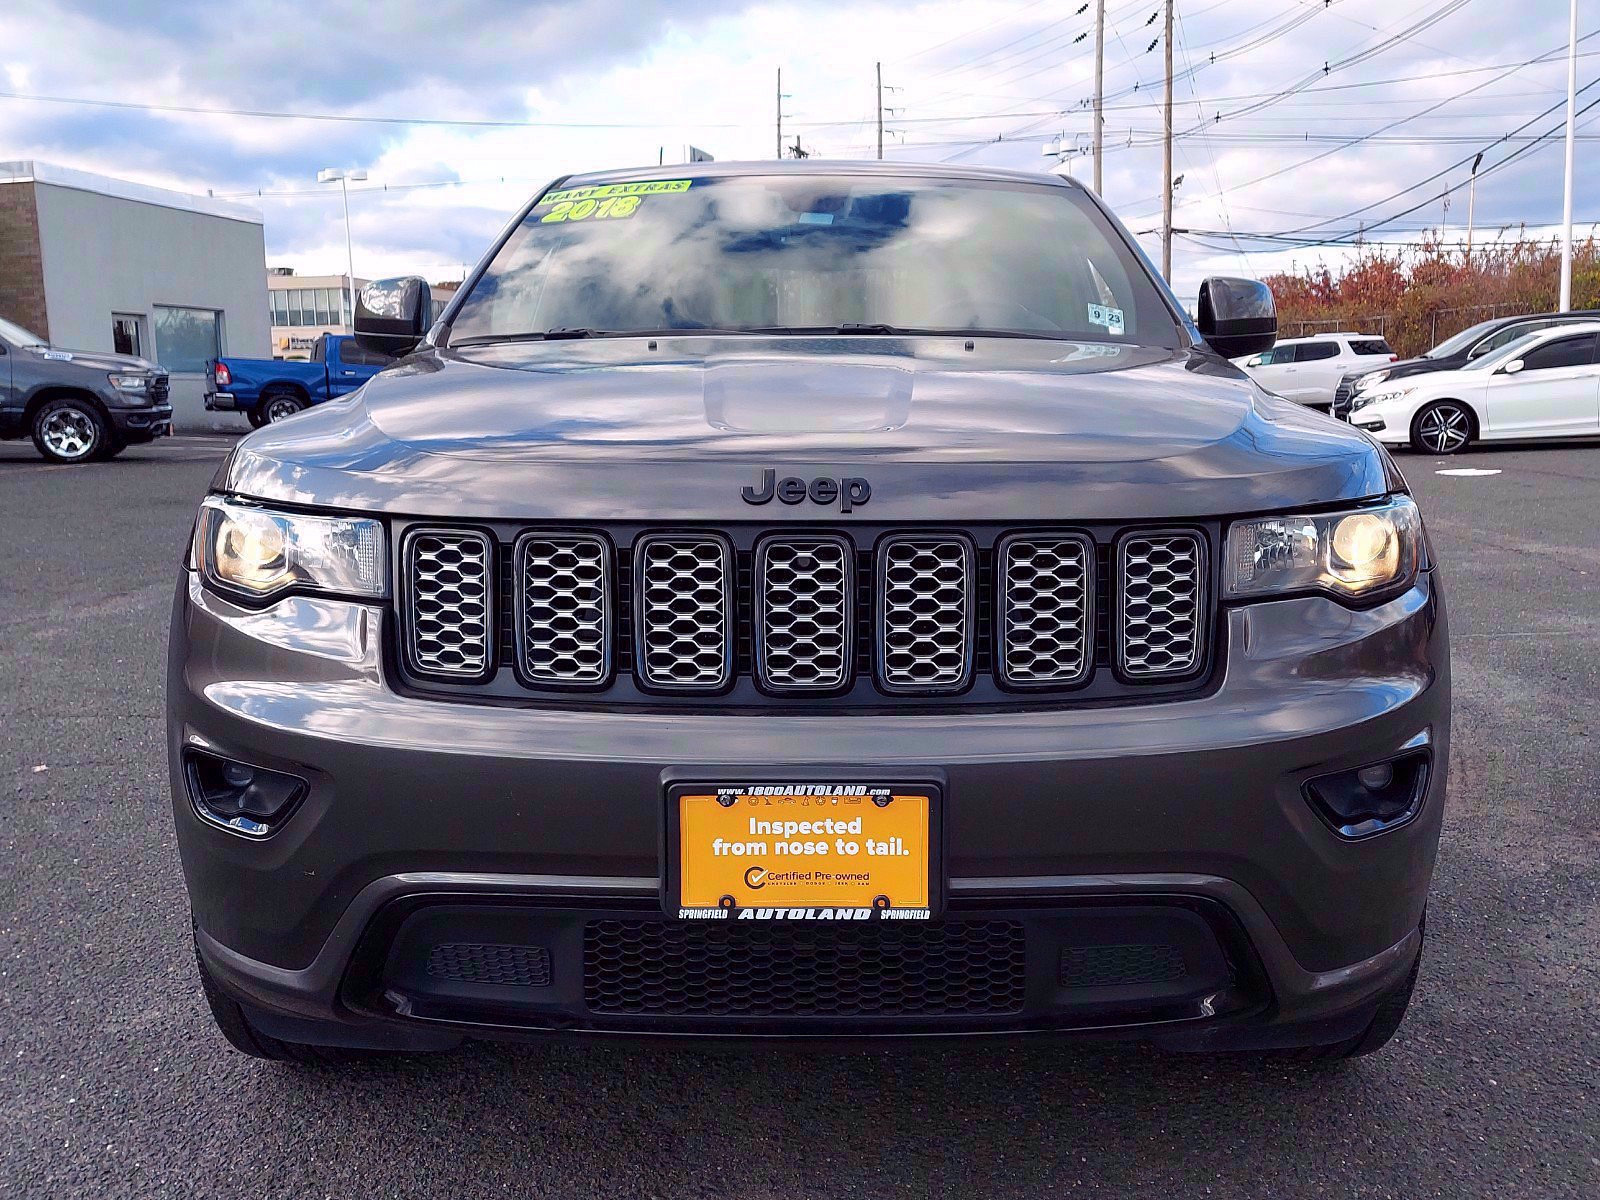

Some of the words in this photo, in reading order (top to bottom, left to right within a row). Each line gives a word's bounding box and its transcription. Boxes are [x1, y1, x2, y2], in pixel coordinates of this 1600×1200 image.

[607, 181, 687, 194] EXTRAS
[541, 195, 642, 223] 2018
[1108, 313, 1121, 324] 23
[740, 468, 871, 513] Jeep
[717, 785, 891, 796] www.1800AUTOLAND.com
[749, 817, 862, 838] Inspected
[712, 838, 767, 856] from
[775, 842, 829, 856] nose
[835, 839, 859, 856] to
[866, 837, 910, 856] tail.
[767, 871, 812, 881] Certified
[815, 871, 870, 881] Pre-owned
[678, 909, 728, 919] SPRINGFIELD
[738, 908, 872, 920] AUTOLAND
[880, 909, 930, 920] SPRINGFIELD
